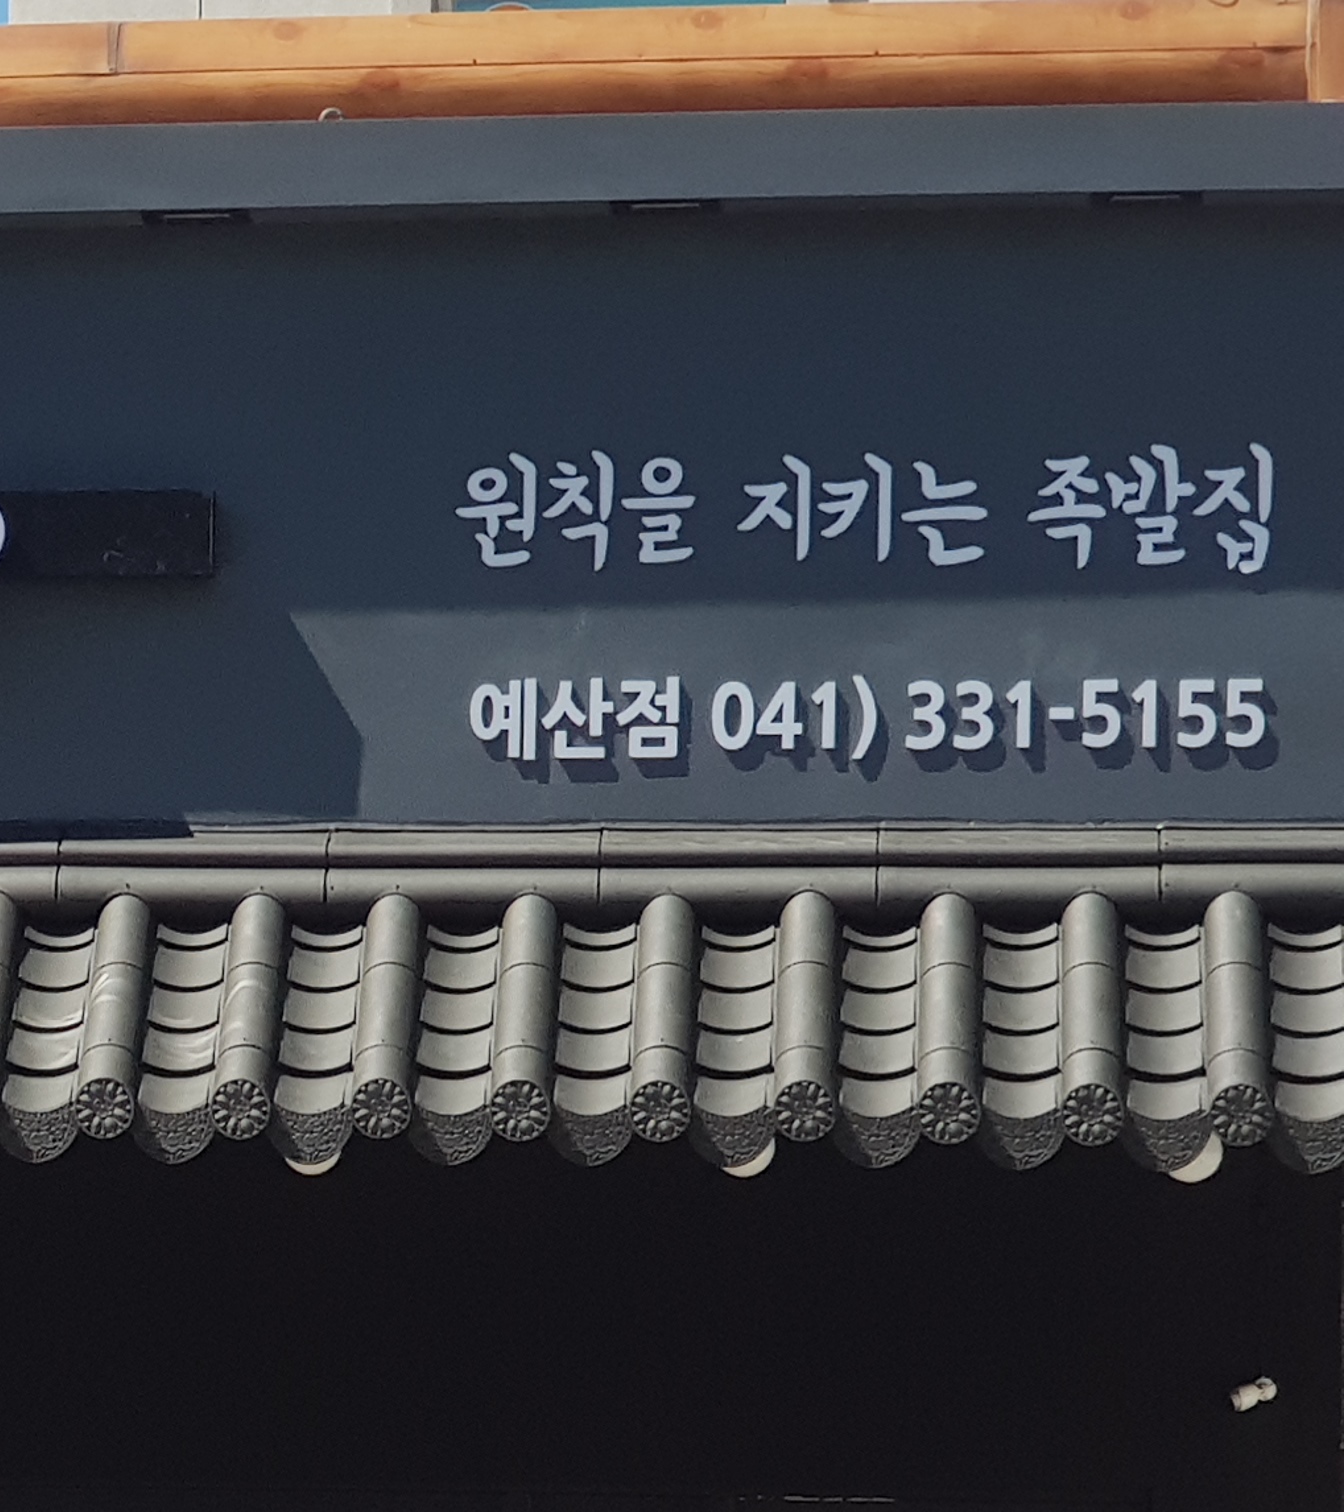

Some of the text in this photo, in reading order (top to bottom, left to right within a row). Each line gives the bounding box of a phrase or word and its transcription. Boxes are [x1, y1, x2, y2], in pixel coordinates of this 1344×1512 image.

[455, 443, 1274, 573] 원칙을 지키는 족발집
[469, 674, 1265, 760] 예산점 041) 331-5155
